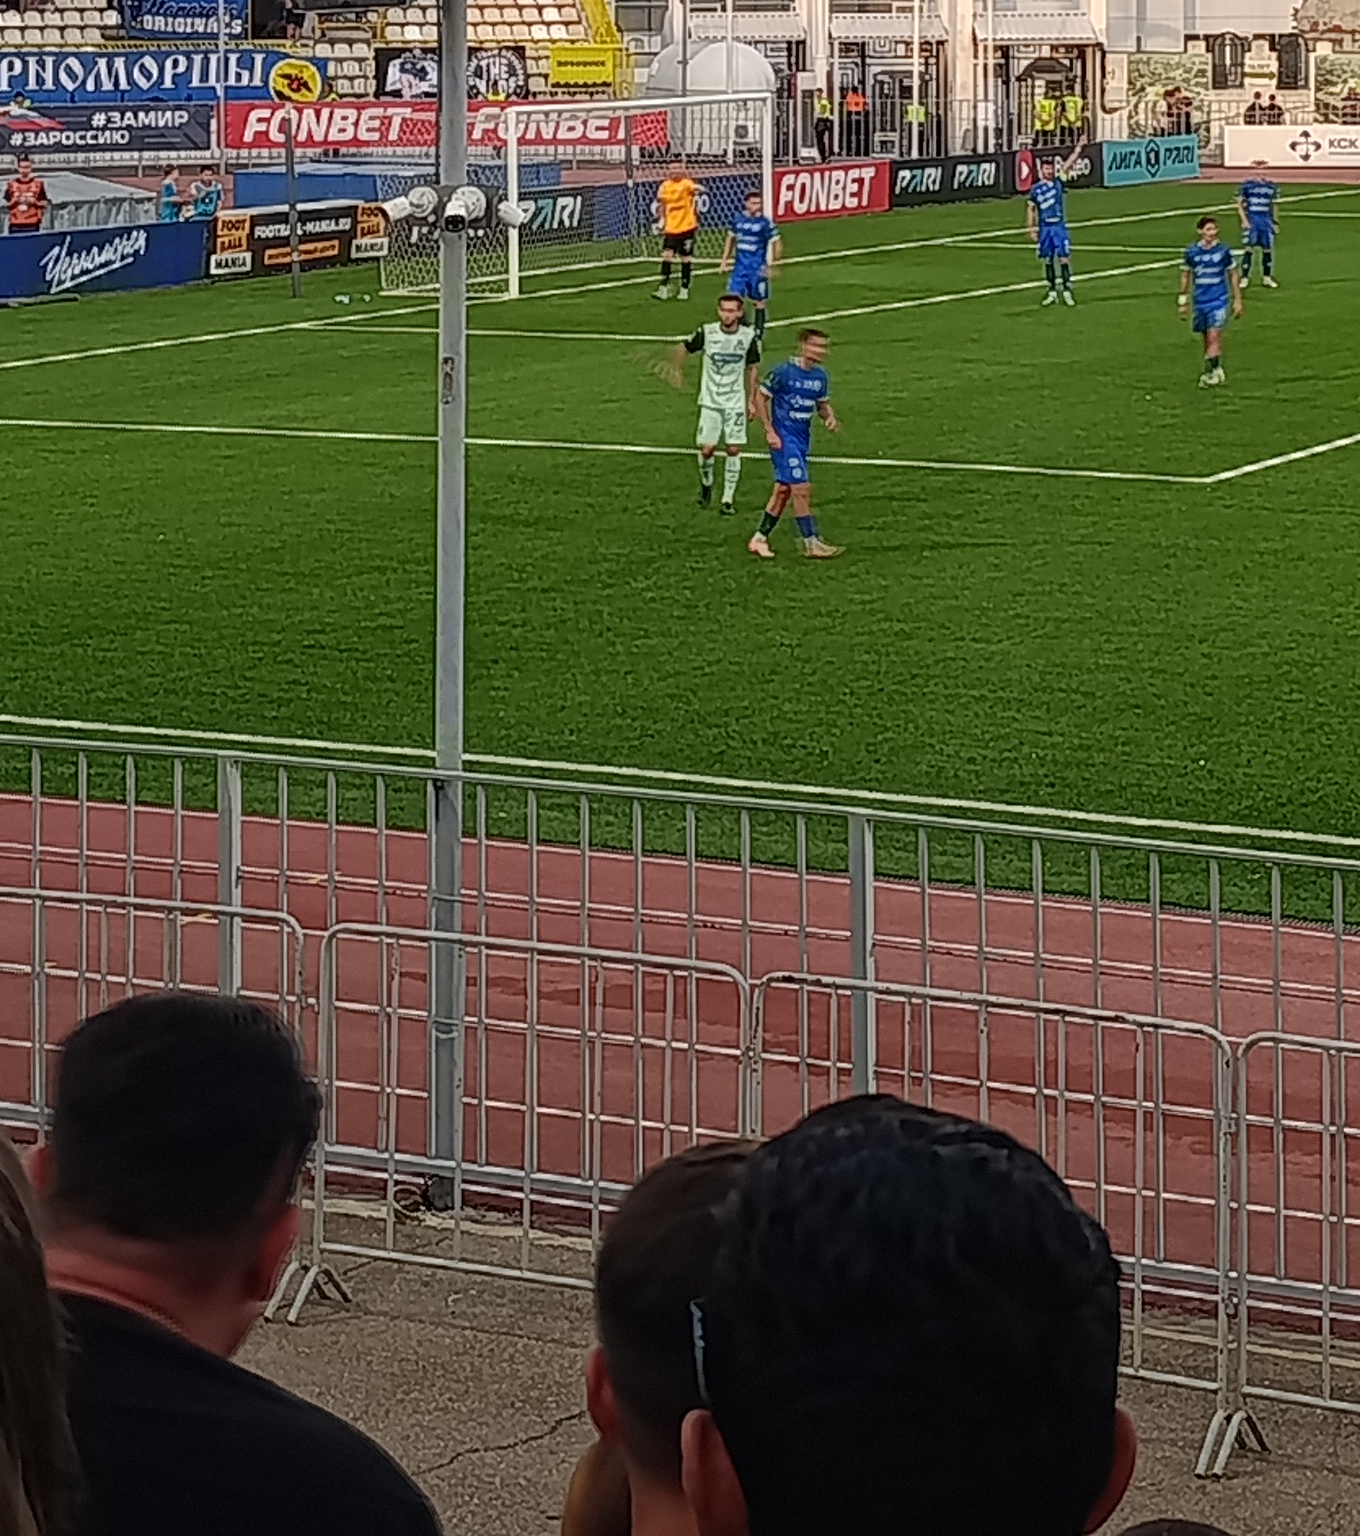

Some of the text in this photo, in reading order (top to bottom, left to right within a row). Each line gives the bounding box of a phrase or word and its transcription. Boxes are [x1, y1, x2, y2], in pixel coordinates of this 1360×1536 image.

[242, 106, 413, 143] FONBET
[777, 166, 876, 216] FONBET
[895, 161, 996, 195] PARI PARI
